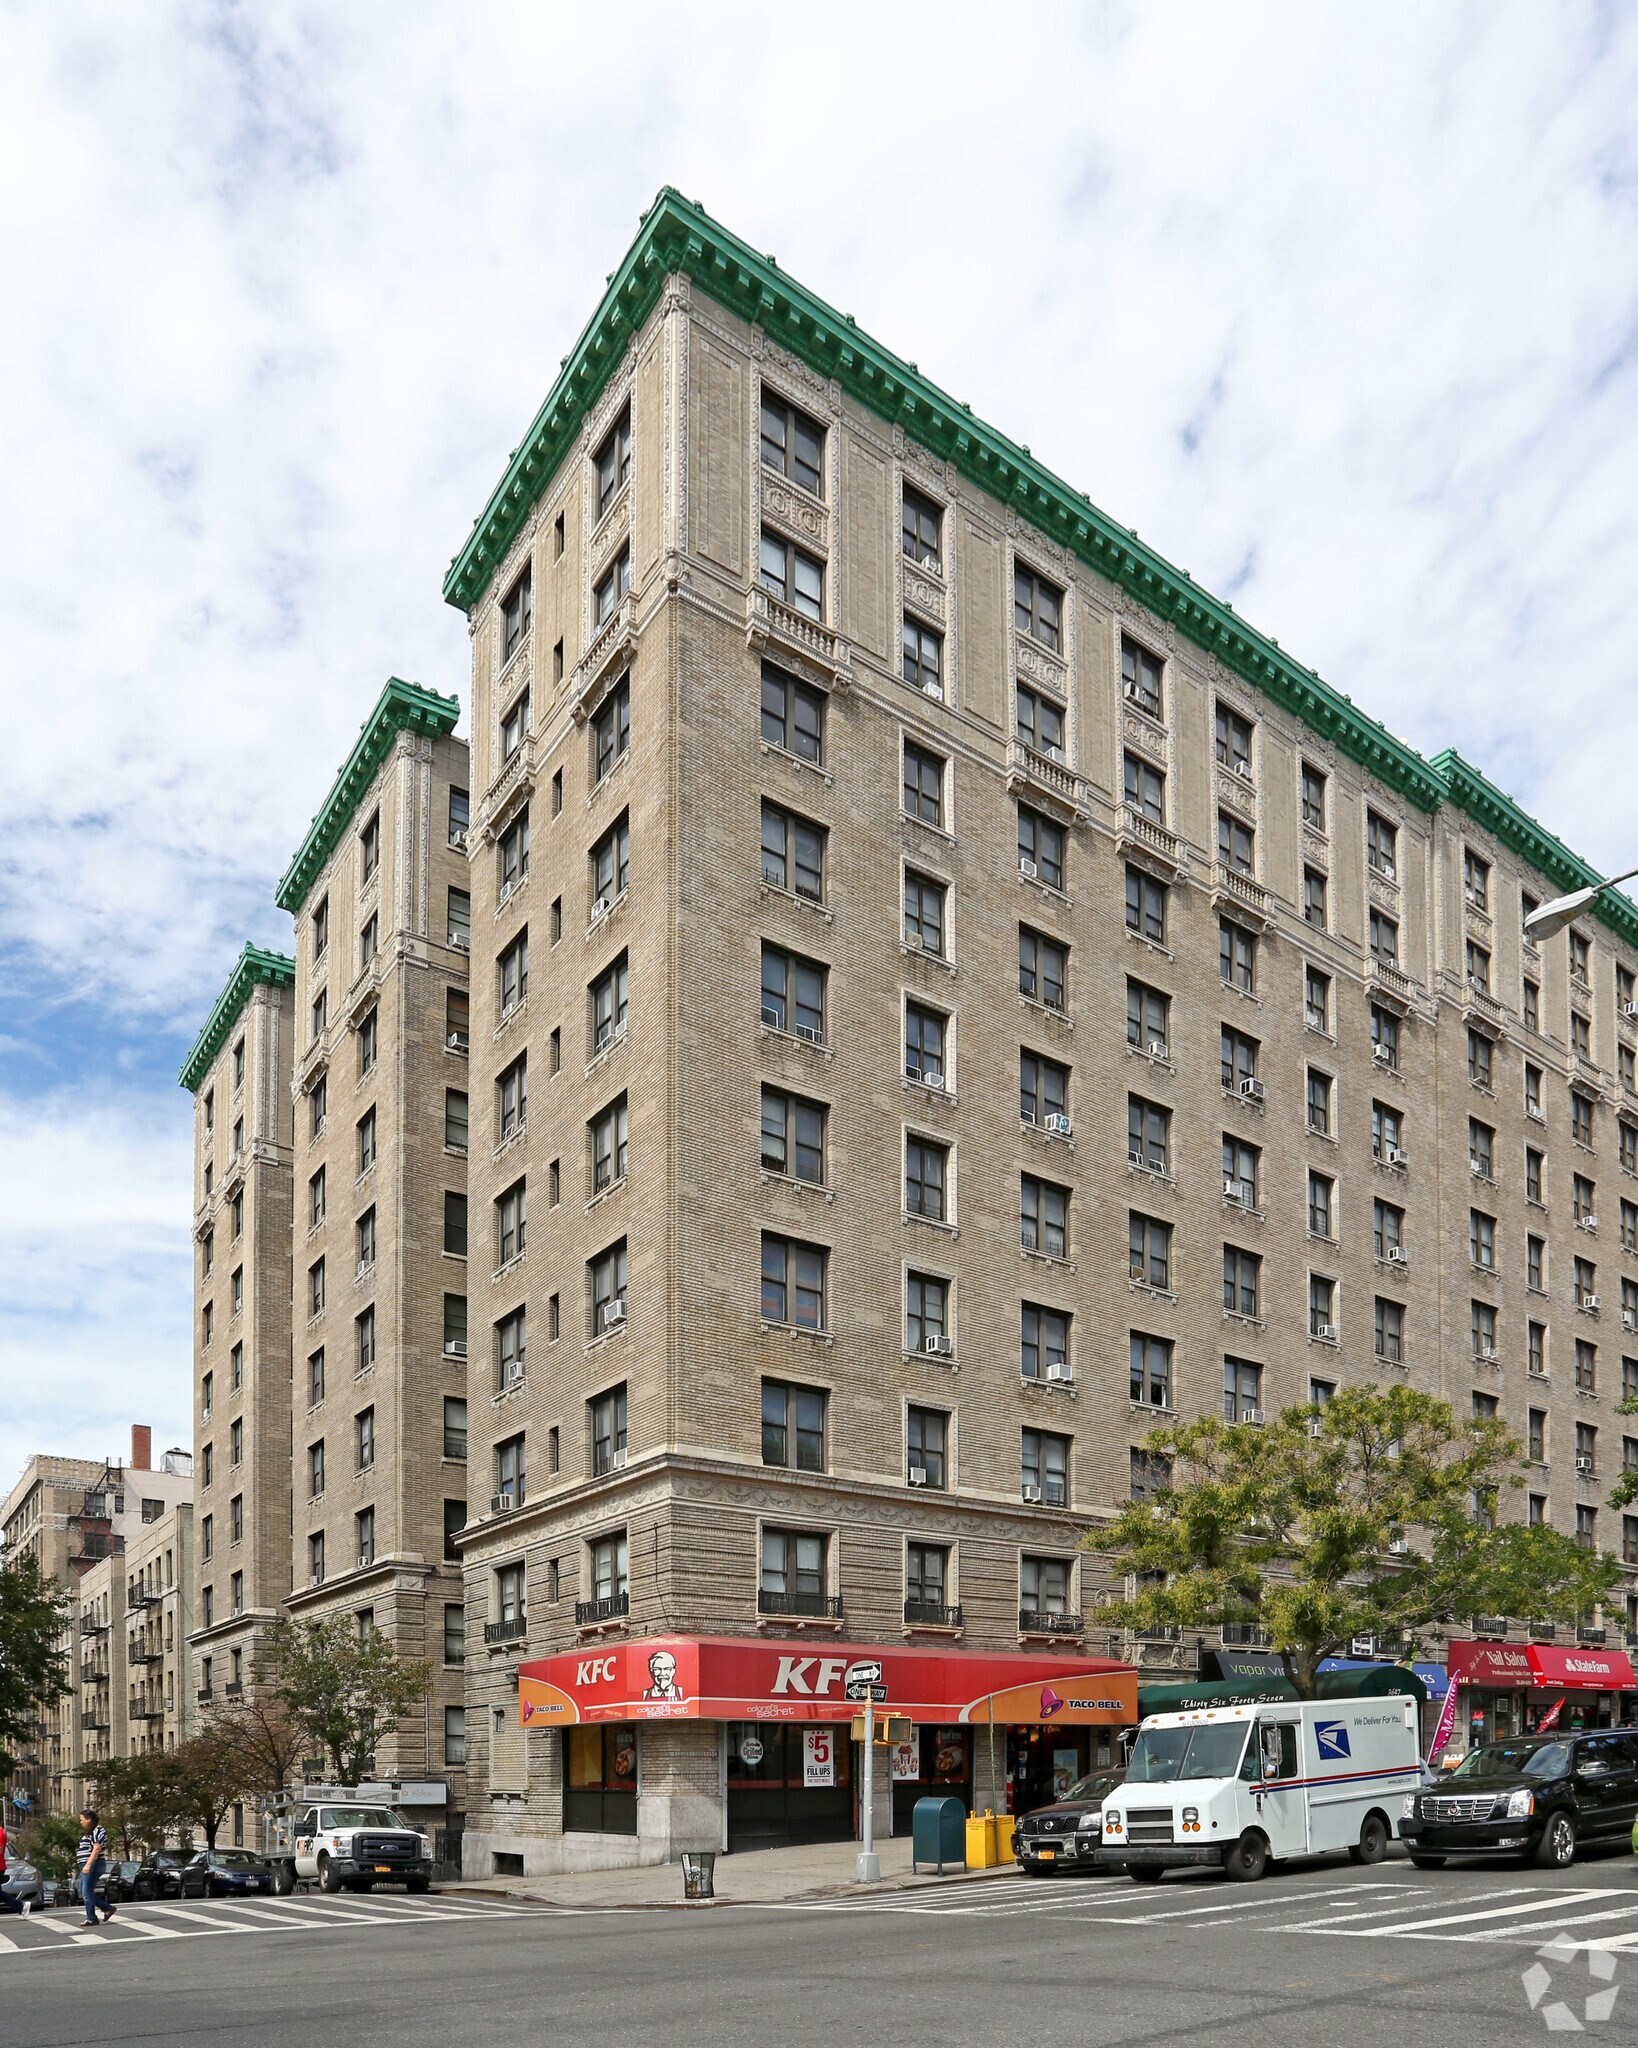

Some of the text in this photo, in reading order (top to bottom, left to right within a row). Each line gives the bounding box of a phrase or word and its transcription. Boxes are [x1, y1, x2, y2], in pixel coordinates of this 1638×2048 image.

[1486, 1650, 1504, 1666] Nail
[1504, 1651, 1528, 1667] Salon
[575, 1656, 617, 1686] KFC
[855, 1669, 877, 1679] ONE WAY
[1229, 1664, 1266, 1677] vapor
[850, 1687, 884, 1697] ONE WAY
[1068, 1700, 1123, 1709] TACO BELL
[1180, 1693, 1284, 1709] Thirty Six Forty Seven
[536, 1704, 564, 1713] TACO BELL
[646, 1706, 689, 1718] secret
[756, 1706, 795, 1719] secret
[1353, 1717, 1362, 1726] We
[1363, 1716, 1381, 1726] Deliver
[1382, 1715, 1391, 1724] For
[808, 1735, 830, 1763] $5
[807, 1767, 831, 1776] FILL UPS
